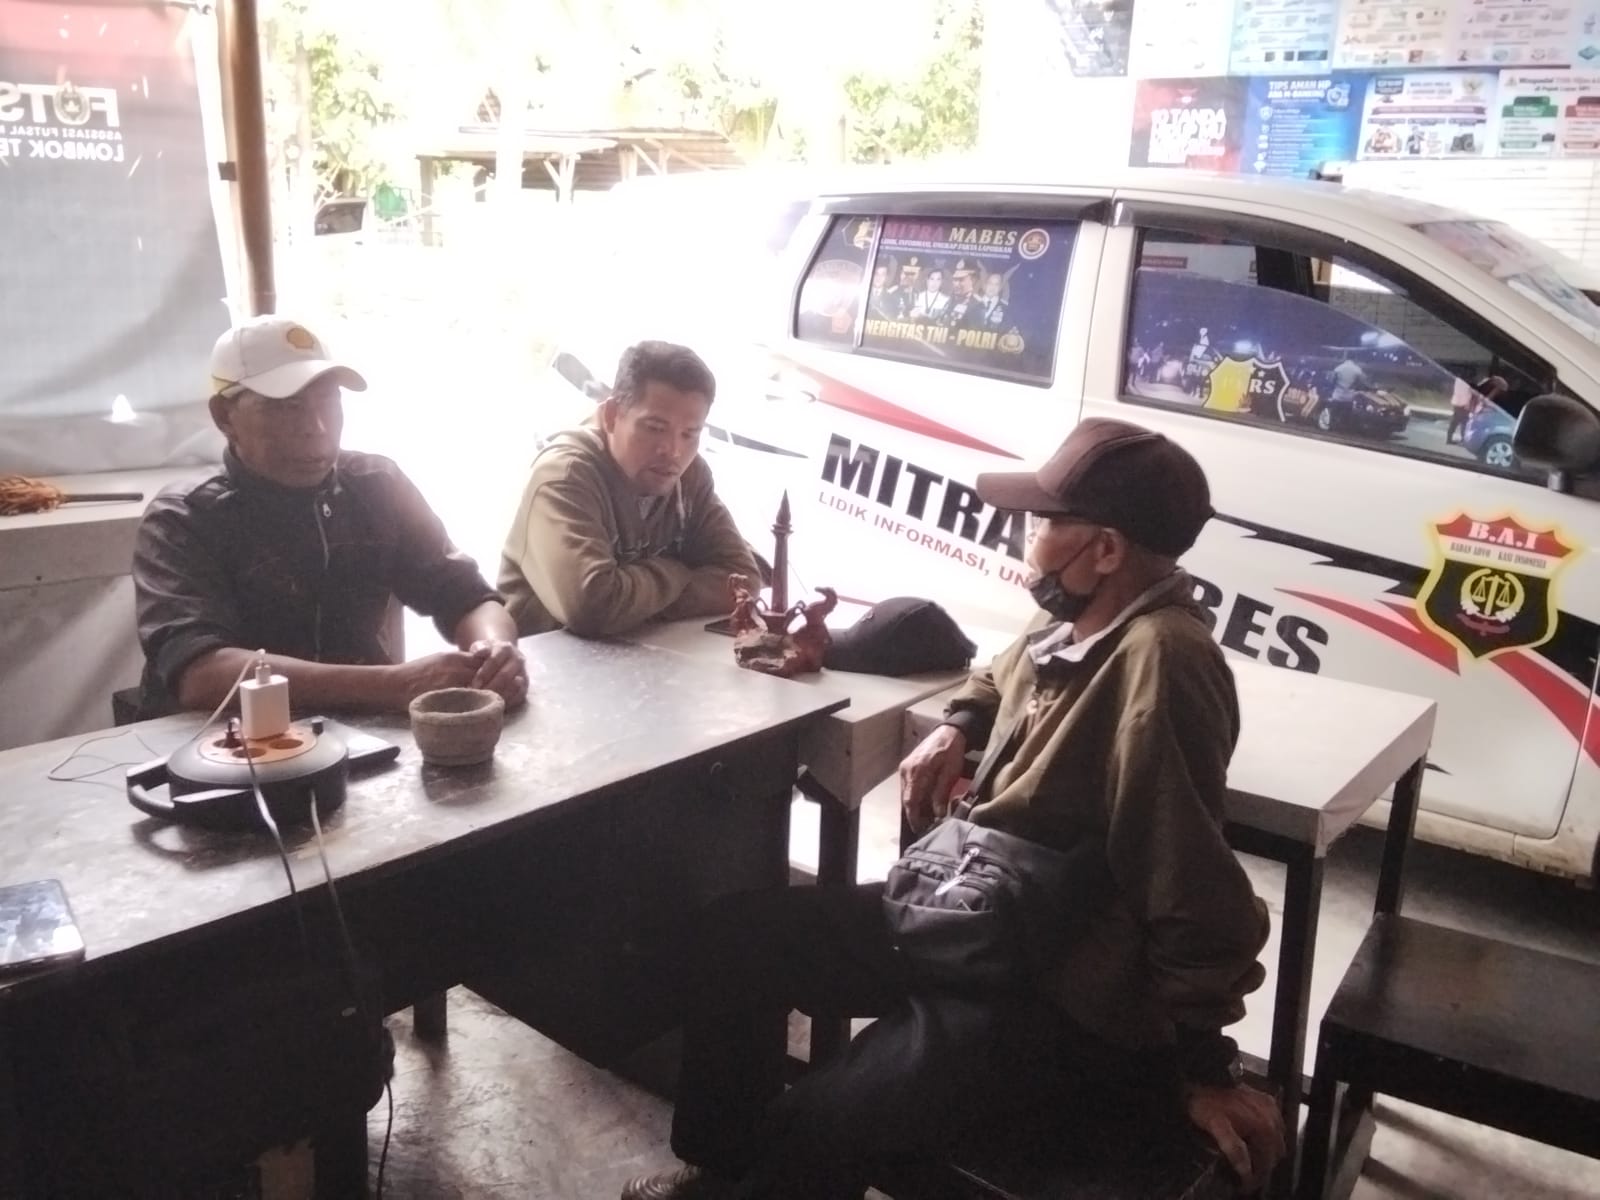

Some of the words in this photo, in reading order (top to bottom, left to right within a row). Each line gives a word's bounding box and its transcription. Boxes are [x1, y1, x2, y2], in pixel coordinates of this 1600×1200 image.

[883, 224, 945, 242] MITRA
[949, 228, 1018, 247] MABES
[925, 326, 948, 343] TNI
[957, 329, 996, 349] POLRI
[821, 432, 1025, 562] MITRA
[818, 491, 867, 521] LIDIK
[874, 514, 990, 576] INFORMASI,
[1468, 522, 1538, 549] B.A.I
